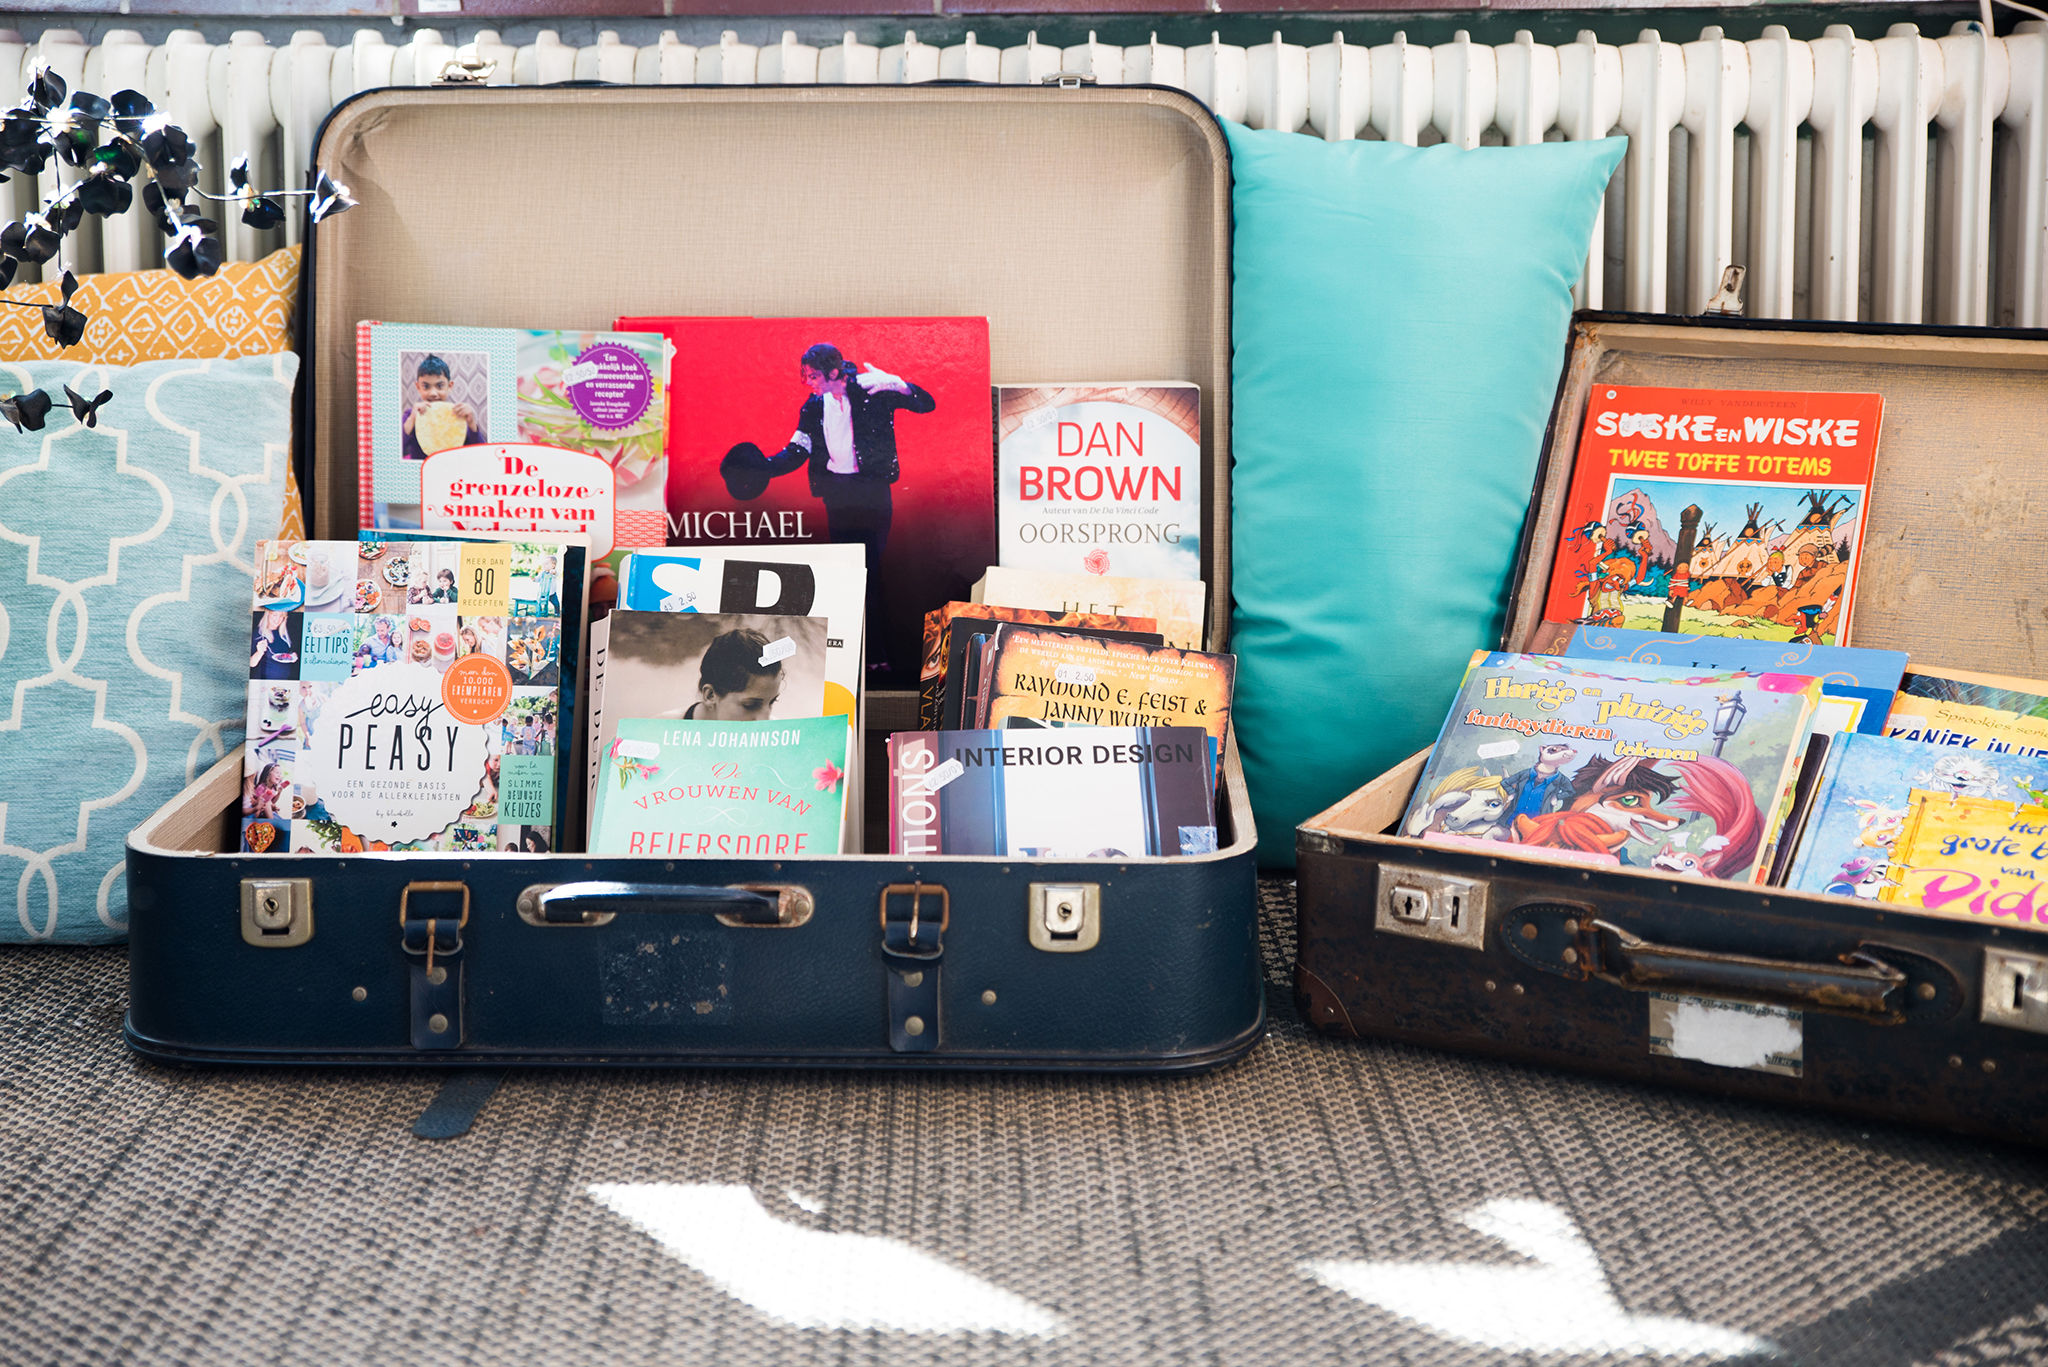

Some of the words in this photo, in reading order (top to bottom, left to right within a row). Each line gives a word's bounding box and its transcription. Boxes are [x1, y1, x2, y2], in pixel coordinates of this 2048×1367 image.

[1681, 398, 1713, 407] WILLY
[1057, 421, 1144, 457] DAN
[1714, 428, 1742, 443] EN
[1743, 416, 1860, 447] WISKE
[495, 447, 539, 477] De
[1608, 448, 1669, 469] TWEE
[1675, 452, 1740, 473] TOFFE
[1746, 455, 1832, 477] TOTEMS
[449, 478, 605, 501] grenzeloze
[1019, 466, 1182, 501] BROWN
[427, 499, 545, 519] smaken
[550, 507, 597, 522] van
[1042, 507, 1071, 515] Auteur
[1089, 507, 1101, 515] De
[1101, 507, 1115, 515] Da
[1115, 507, 1137, 515] Vinci
[1138, 507, 1160, 515] Code
[664, 511, 813, 540] MICHAEL
[1019, 523, 1182, 545] OORSPRONG
[466, 558, 487, 566] MEER
[490, 558, 505, 566] DAN
[474, 567, 495, 596] 80
[462, 598, 504, 607] RECEPTEN
[678, 591, 697, 606] 2.50
[1031, 648, 1060, 660] WERELD
[1088, 656, 1115, 667] ANDERE
[1116, 659, 1136, 669] KANT
[1136, 662, 1151, 672] VAN
[1152, 664, 1165, 673] DE
[1160, 656, 1180, 666] OVER
[463, 676, 494, 685] 10.000
[1075, 671, 1095, 683] 2.50
[452, 685, 503, 697] EXEMPLAREN
[1116, 688, 1132, 706] E.
[1138, 691, 1190, 714] FEIST
[1194, 699, 1208, 715] &
[1483, 675, 1578, 712] Harige
[1582, 685, 1603, 698] en
[345, 693, 445, 740] easy
[1041, 700, 1104, 726] JANNY
[1593, 692, 1709, 741] pluizige
[1935, 709, 2013, 731] Sprookjes
[1464, 708, 1613, 742] fantasydieren
[337, 723, 459, 773] PEASY
[662, 730, 702, 747] LENA
[707, 729, 802, 748] JOHANNSON
[955, 746, 1083, 769] INTERIOR
[1092, 743, 1194, 765] DESIGN
[1612, 738, 1699, 763] tekenen
[711, 761, 743, 779] De
[346, 780, 364, 788] EEN
[370, 780, 411, 790] GEZONDE
[417, 781, 447, 790] BASIS
[507, 779, 543, 788] SLIMME
[331, 791, 355, 799] VOOR
[361, 791, 372, 799] DE
[378, 791, 461, 801] ALLERKLEINSTEN
[632, 784, 760, 810] VROUWEN
[766, 788, 813, 816] VAN
[504, 802, 542, 818] KEUZES
[1939, 834, 2021, 857] grote
[2000, 866, 2036, 881] van
